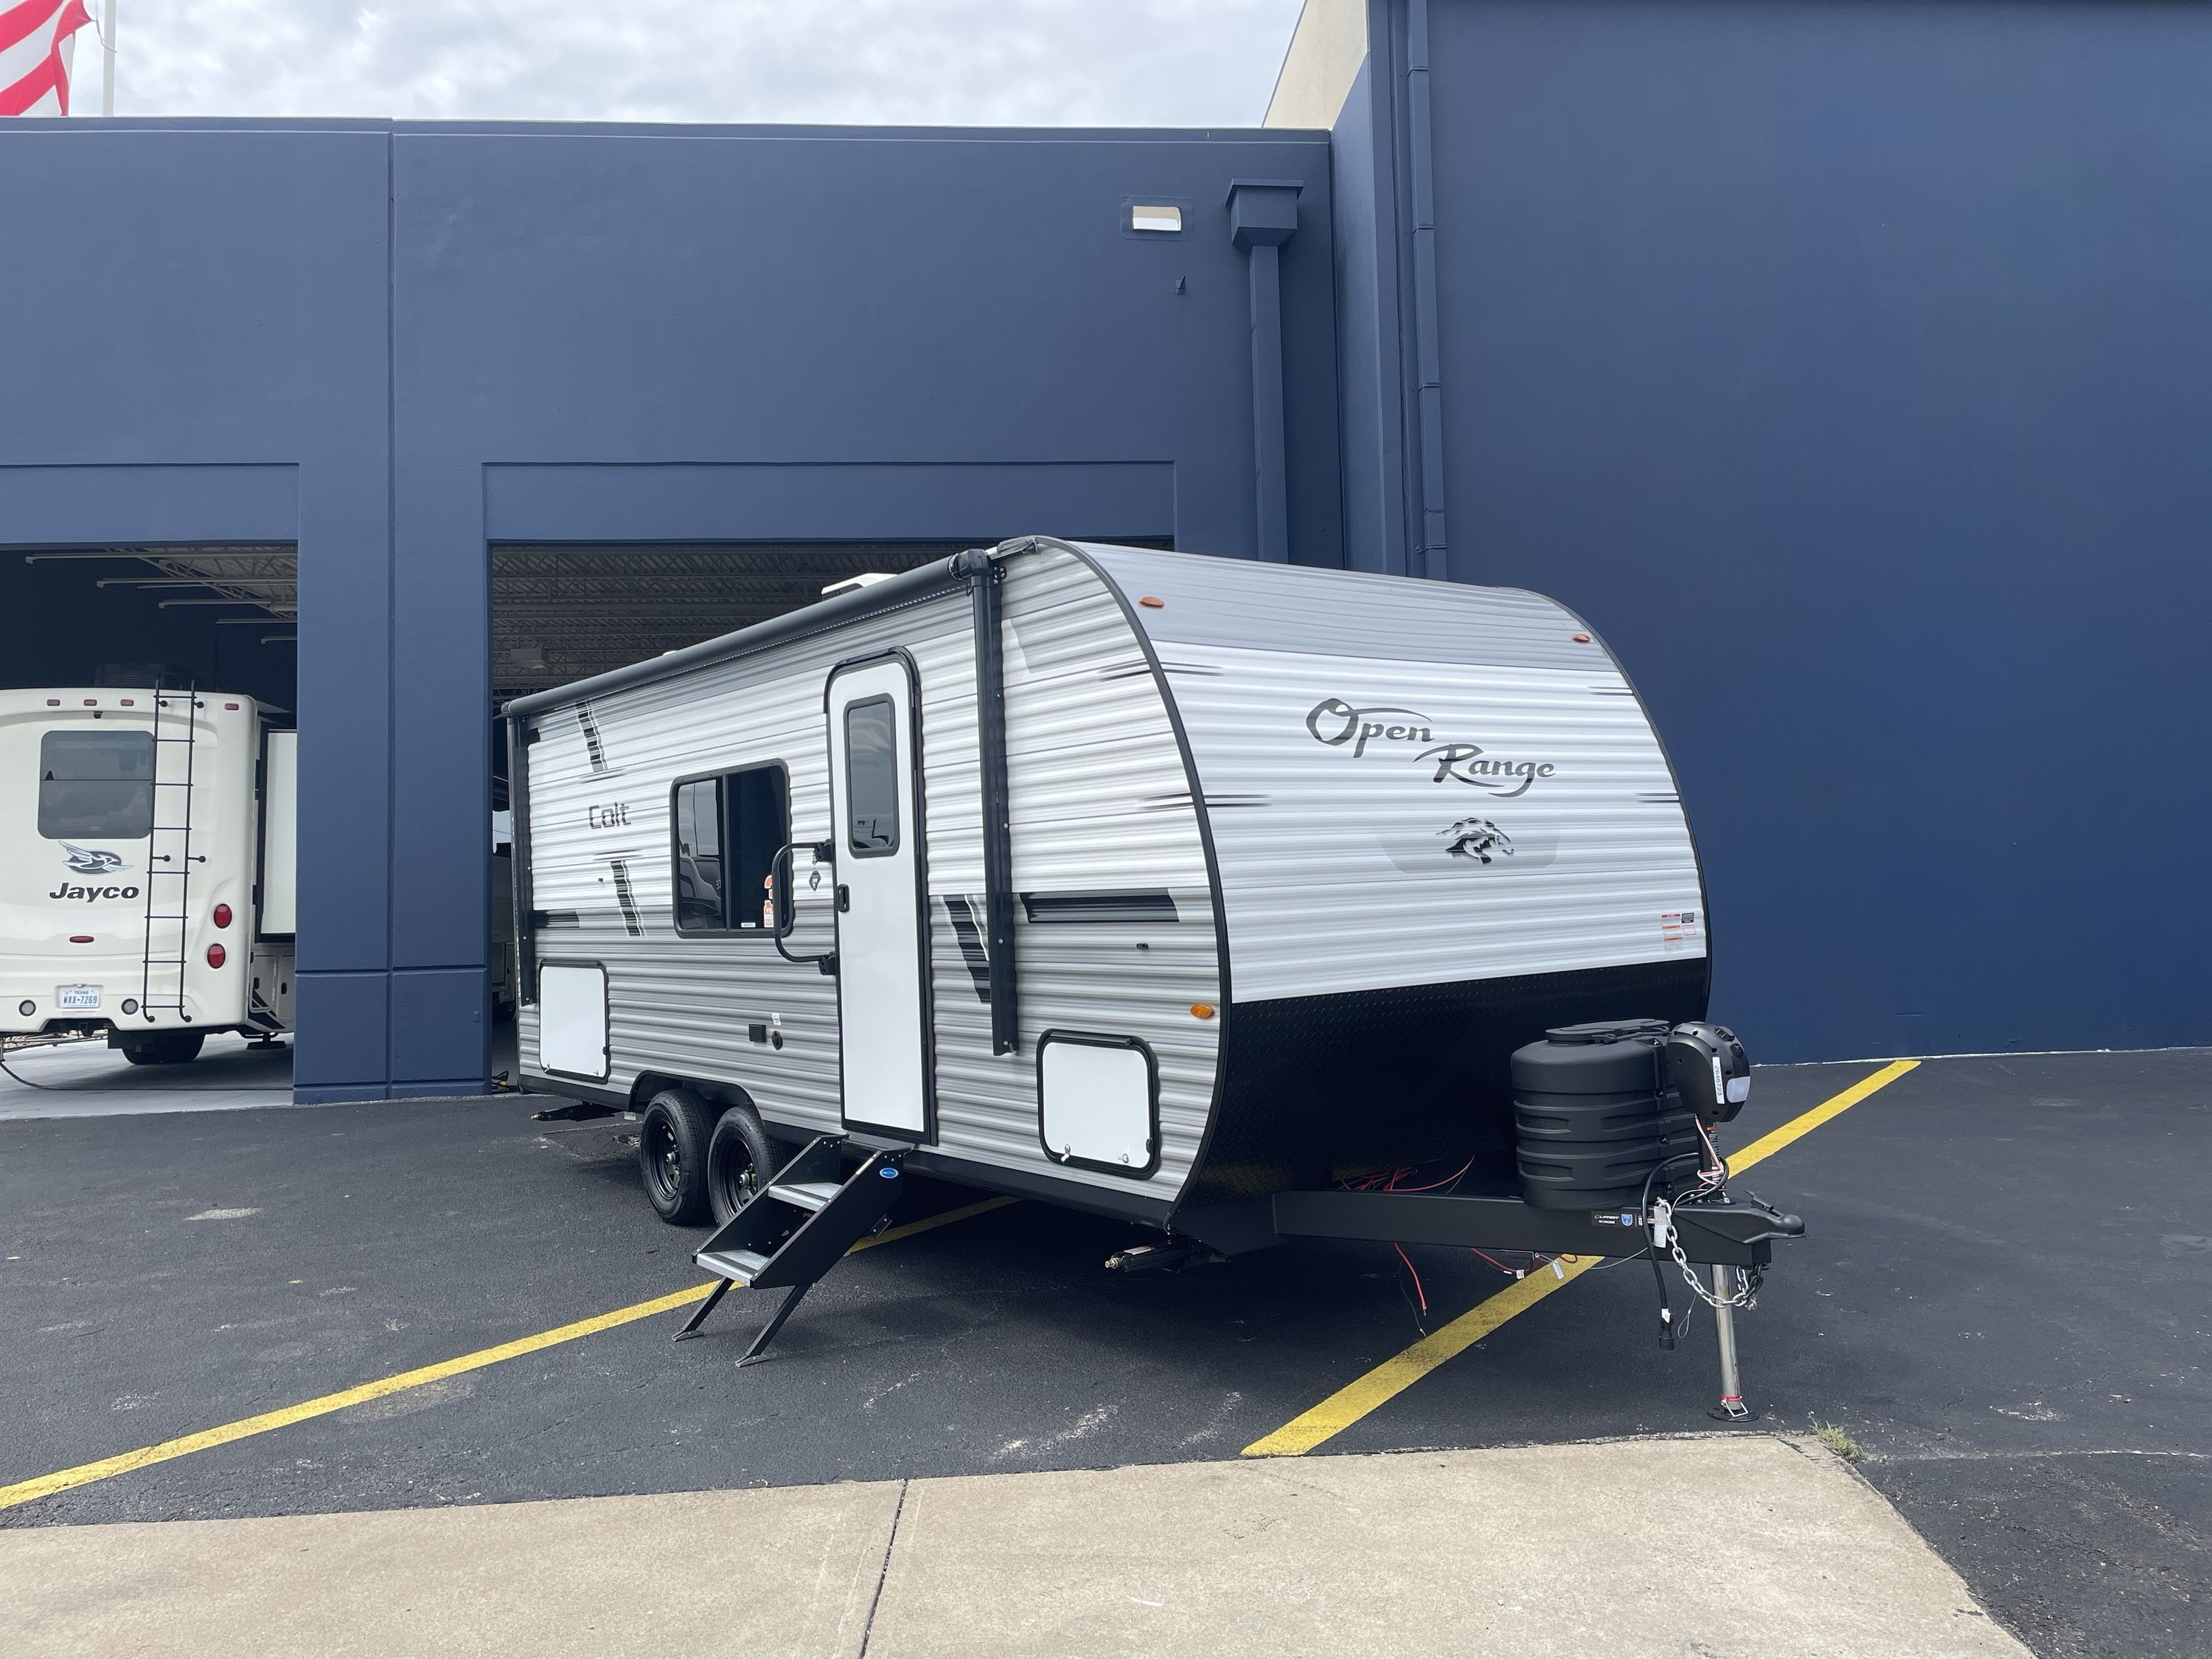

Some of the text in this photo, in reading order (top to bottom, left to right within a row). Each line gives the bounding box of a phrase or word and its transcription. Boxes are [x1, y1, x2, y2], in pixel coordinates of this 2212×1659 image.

[1306, 698, 1435, 758] Open
[1413, 743, 1557, 798] Range
[588, 802, 632, 830] Colt
[49, 882, 139, 903] Jayco
